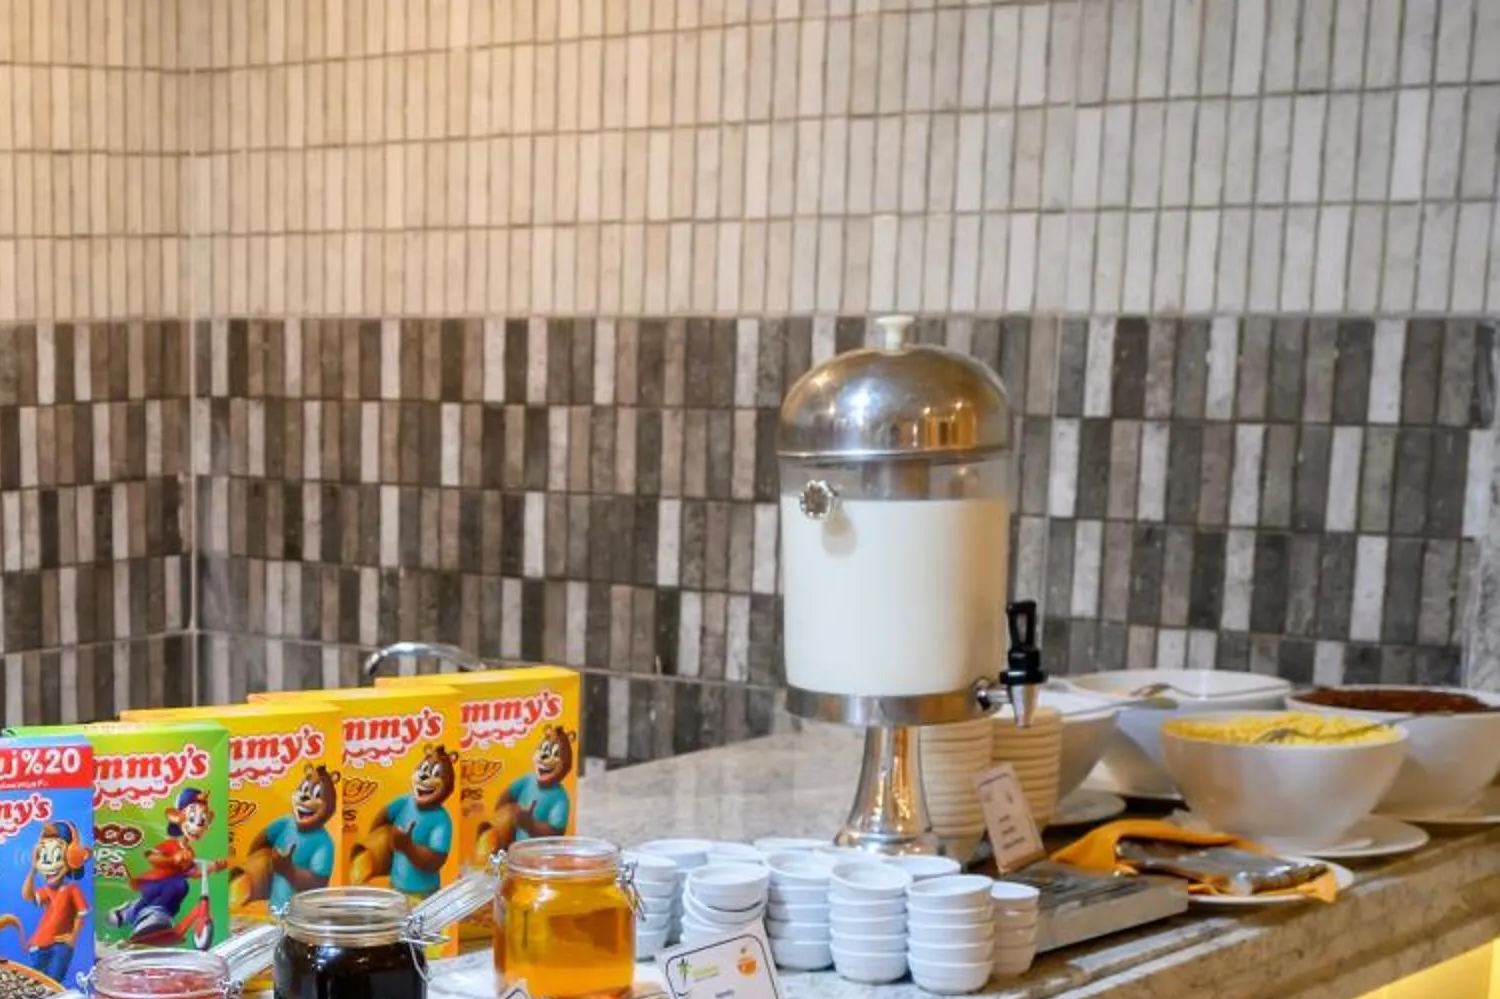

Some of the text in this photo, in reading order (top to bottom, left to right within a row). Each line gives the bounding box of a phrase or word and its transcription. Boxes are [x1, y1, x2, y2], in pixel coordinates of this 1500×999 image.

[343, 709, 442, 743] mmy's
[461, 692, 561, 725] mmy's
[229, 726, 323, 763] mmy's
[93, 745, 208, 783] mmy's
